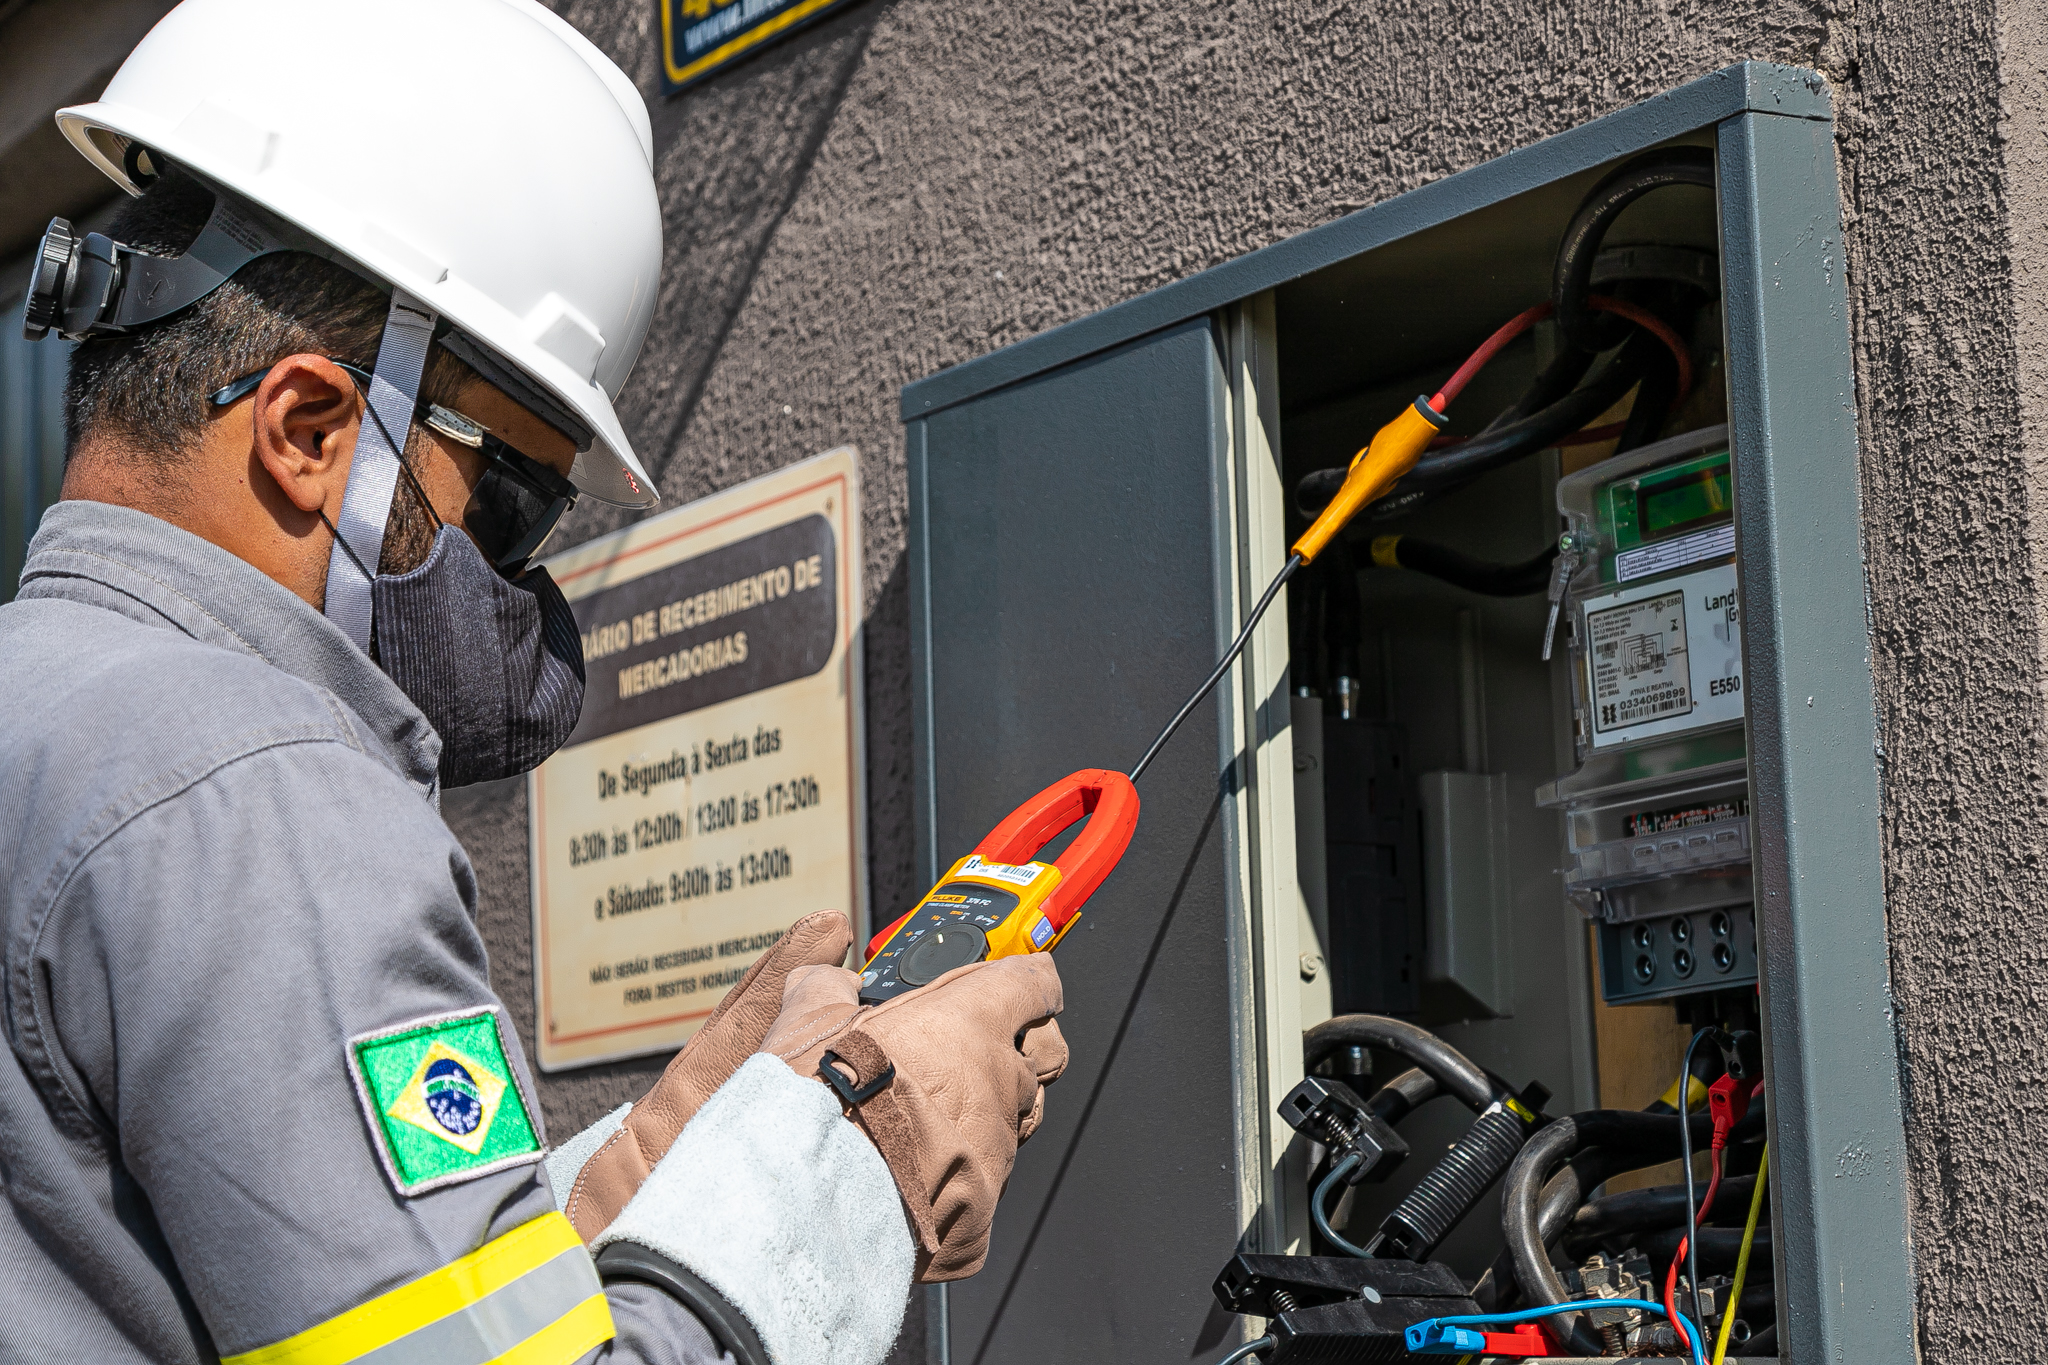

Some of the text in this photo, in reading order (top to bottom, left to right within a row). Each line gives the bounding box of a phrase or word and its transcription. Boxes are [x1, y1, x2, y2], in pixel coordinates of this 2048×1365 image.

[581, 554, 822, 663] RÁRIO DE RECEBIMENTO DE
[618, 630, 748, 700] MERCADORIAS
[1620, 687, 1686, 710] 0334069899
[1710, 675, 1740, 697] E550
[598, 771, 617, 801] De
[622, 751, 686, 797] Segunda
[705, 734, 749, 771] Sexta
[753, 725, 782, 757] das
[633, 813, 682, 850] 12:00h
[594, 894, 605, 921] e
[1036, 925, 1051, 942] HOLD
